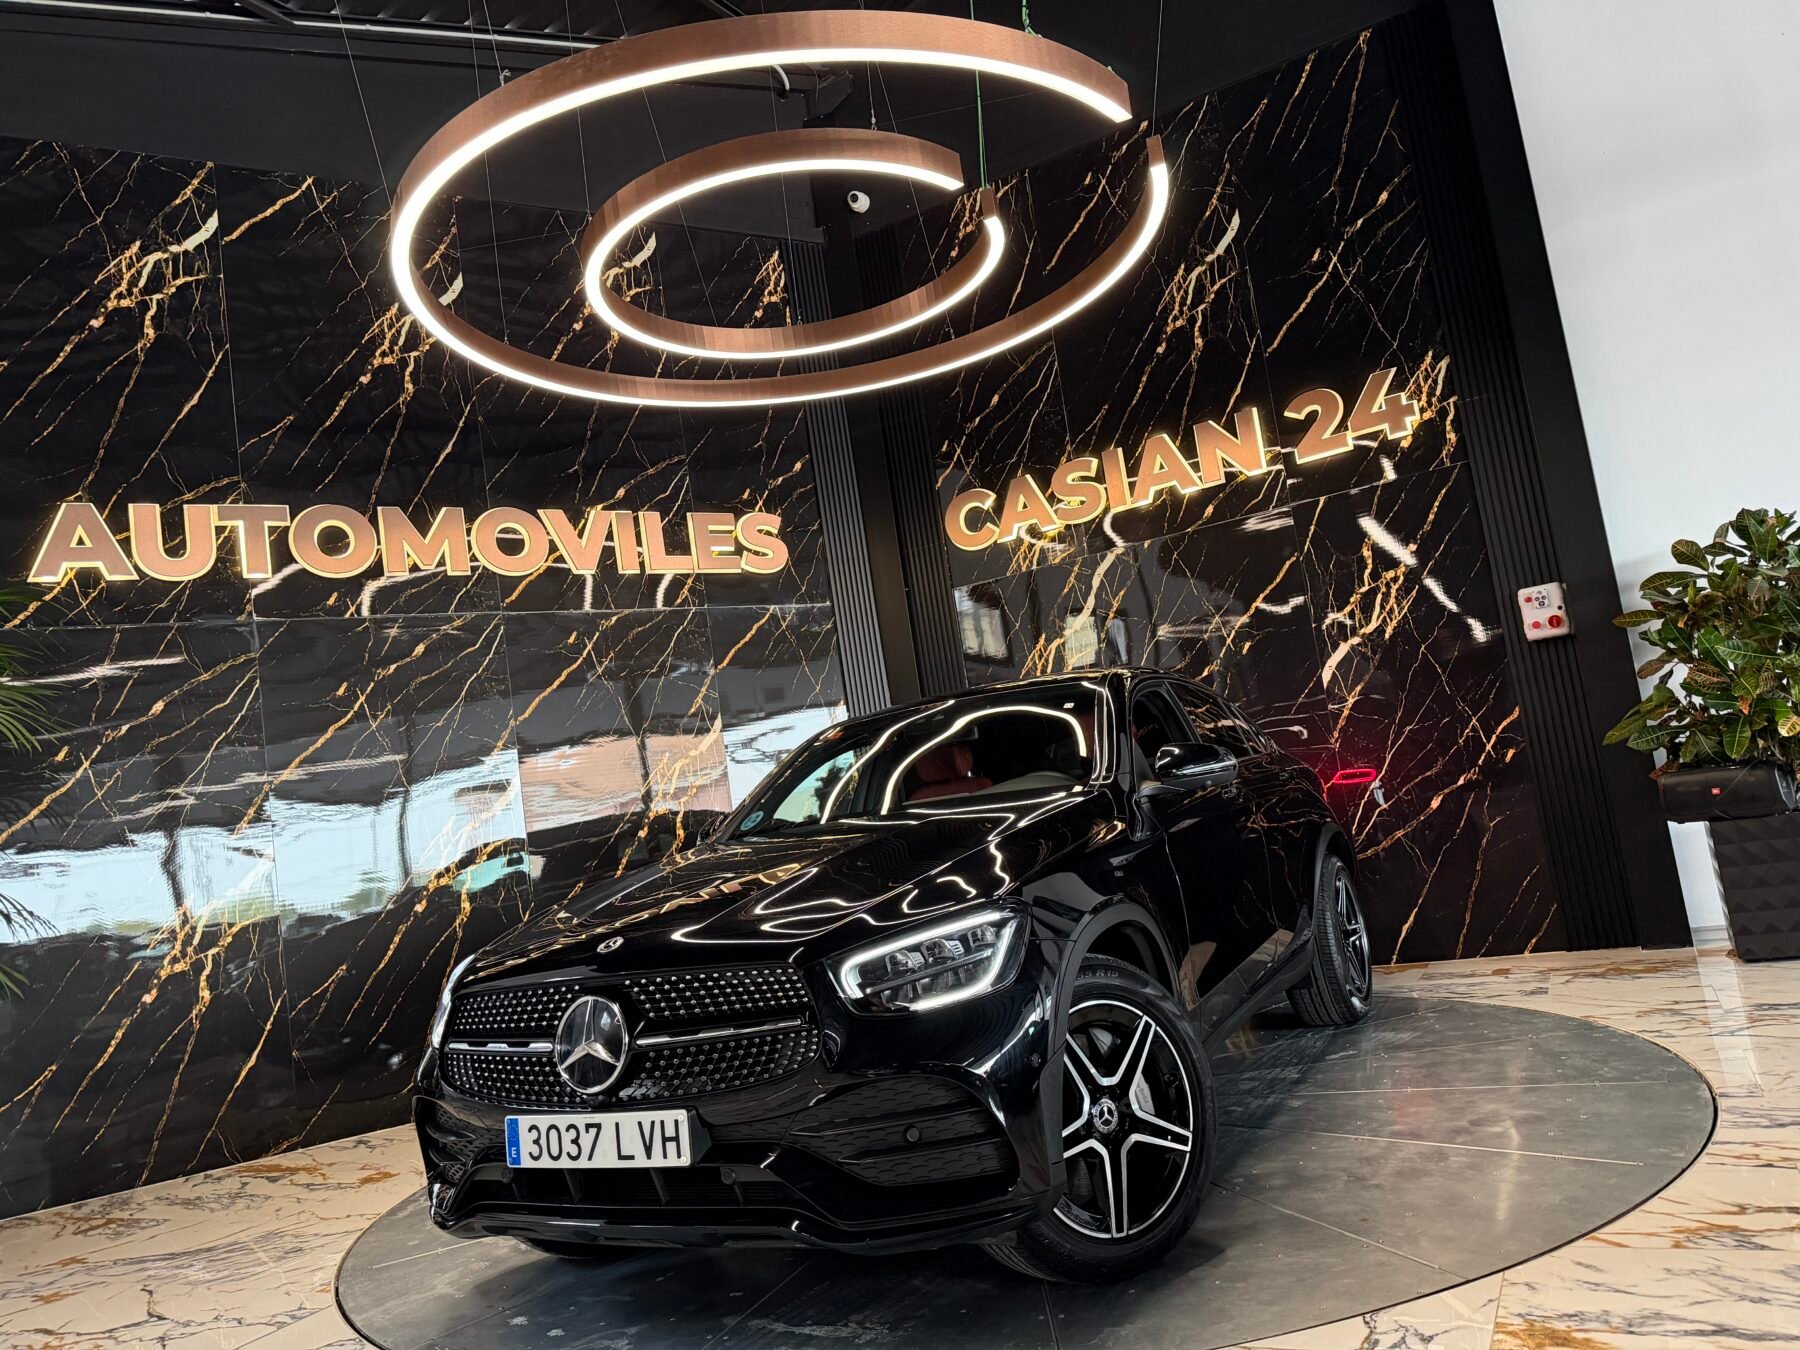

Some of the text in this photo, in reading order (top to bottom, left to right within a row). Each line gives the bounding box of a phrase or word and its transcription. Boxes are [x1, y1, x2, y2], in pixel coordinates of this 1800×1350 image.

[944, 366, 1420, 551] CASIAN 24
[27, 502, 789, 583] AUTOMOVILES
[511, 1147, 517, 1158] E
[527, 1119, 682, 1162] 3037 LVH
